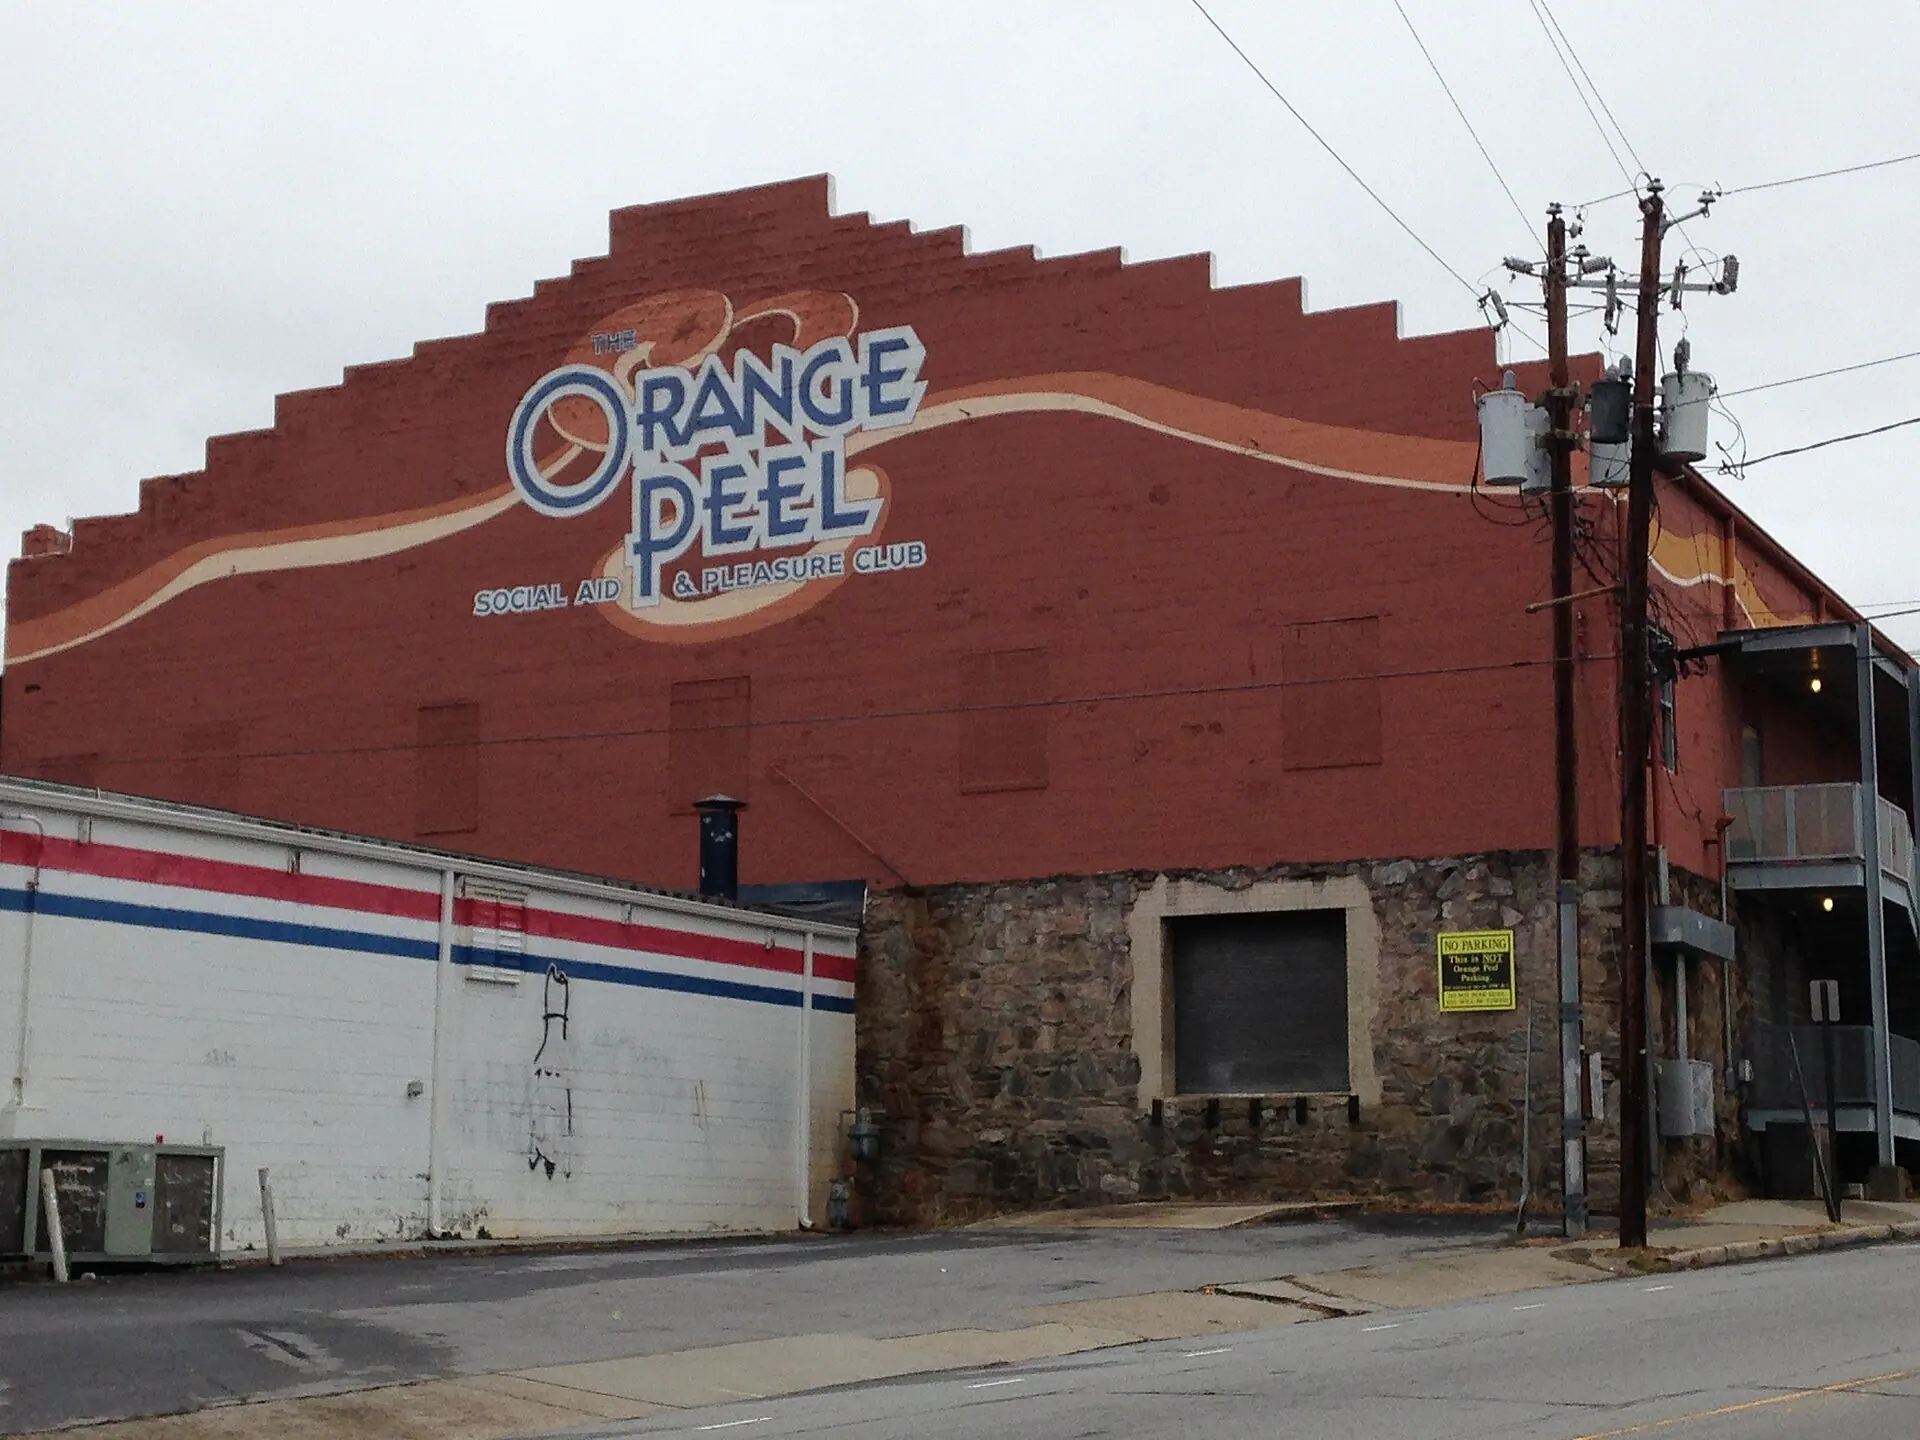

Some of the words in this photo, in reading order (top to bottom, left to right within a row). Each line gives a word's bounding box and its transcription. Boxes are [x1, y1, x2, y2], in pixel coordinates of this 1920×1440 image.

[591, 328, 637, 355] THE
[508, 328, 926, 517] ORANGE
[627, 440, 882, 606] PEEL
[474, 586, 567, 615] SOCIAL
[574, 578, 621, 605] AID
[674, 572, 694, 595] &
[700, 553, 844, 594] PLEASURE
[854, 541, 926, 573] CLUB
[1444, 941, 1458, 951] NO
[1462, 938, 1506, 951] PARKING
[1449, 955, 1468, 963] This
[1482, 954, 1503, 963] NOT
